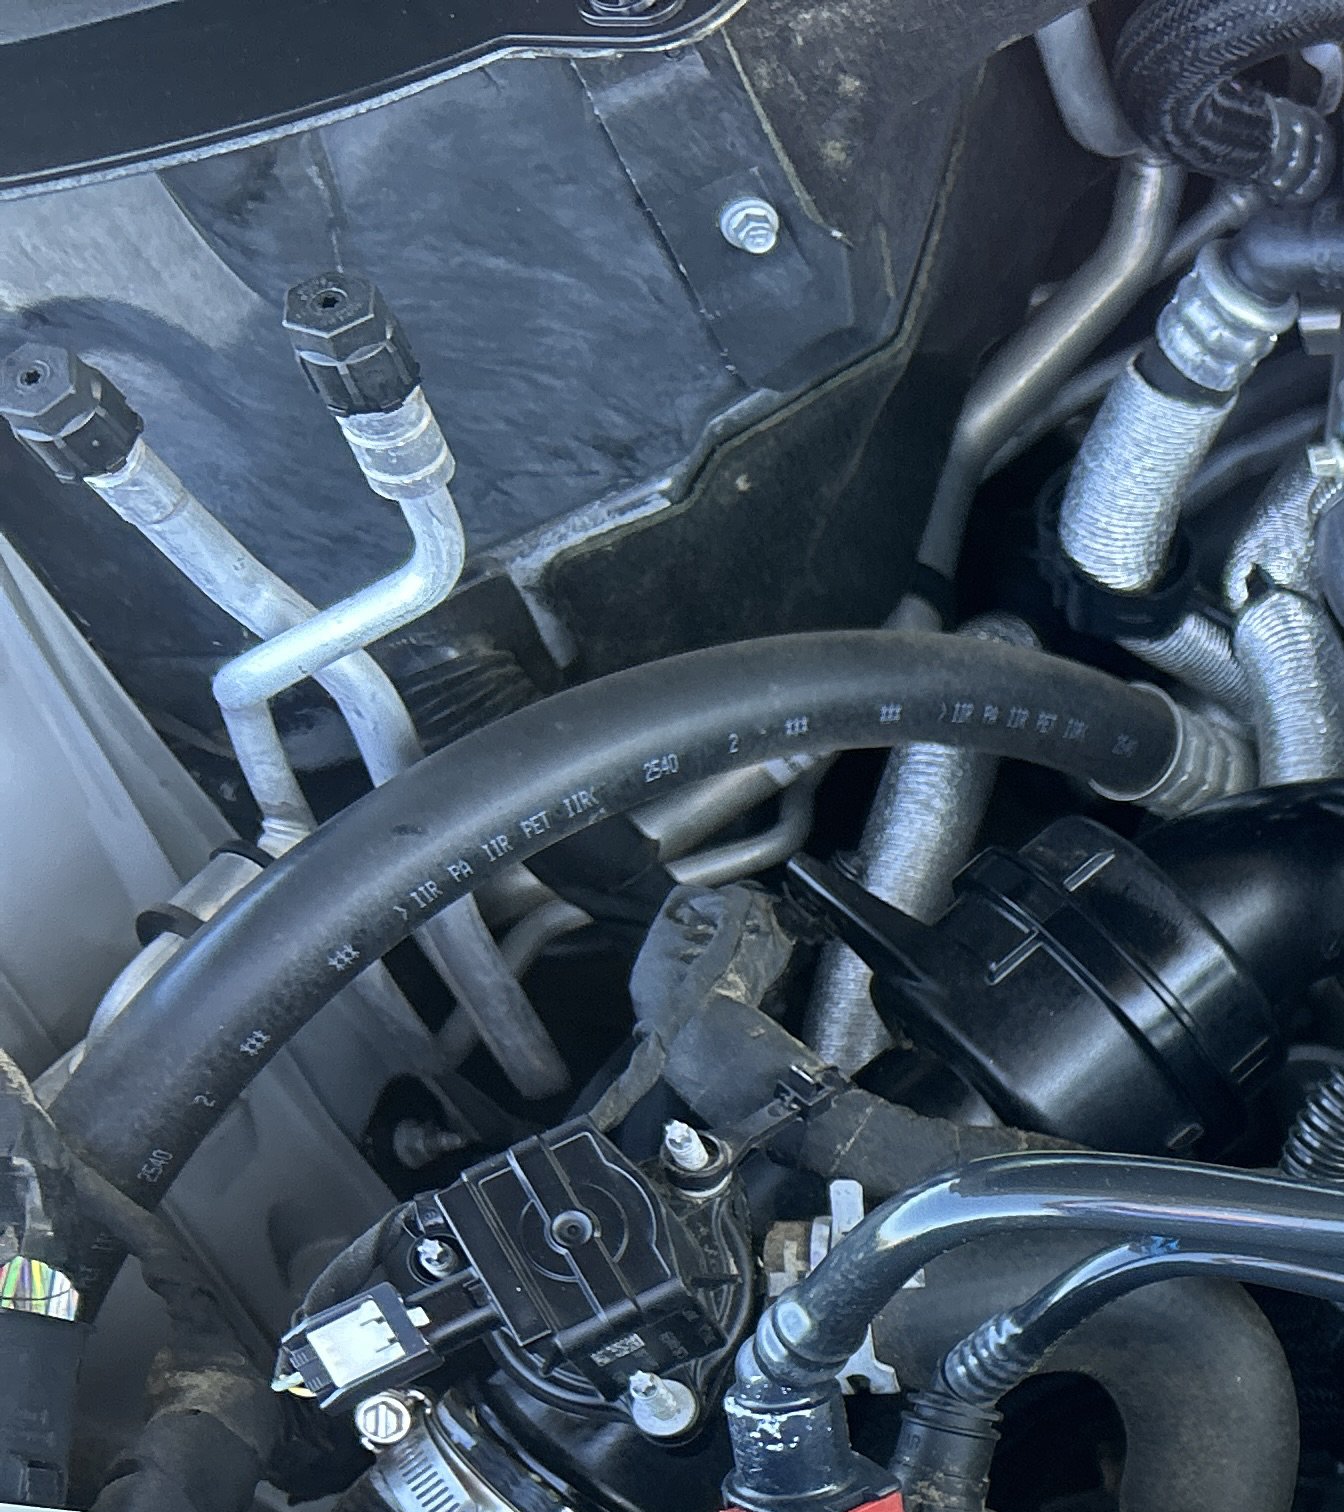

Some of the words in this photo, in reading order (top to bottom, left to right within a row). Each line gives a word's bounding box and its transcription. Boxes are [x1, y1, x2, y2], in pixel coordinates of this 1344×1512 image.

[642, 753, 681, 784] 2540
[728, 732, 740, 755] 2
[446, 858, 475, 884] PA
[480, 833, 515, 864] IIR
[519, 810, 553, 840] PET
[136, 1148, 174, 1184] 2540
